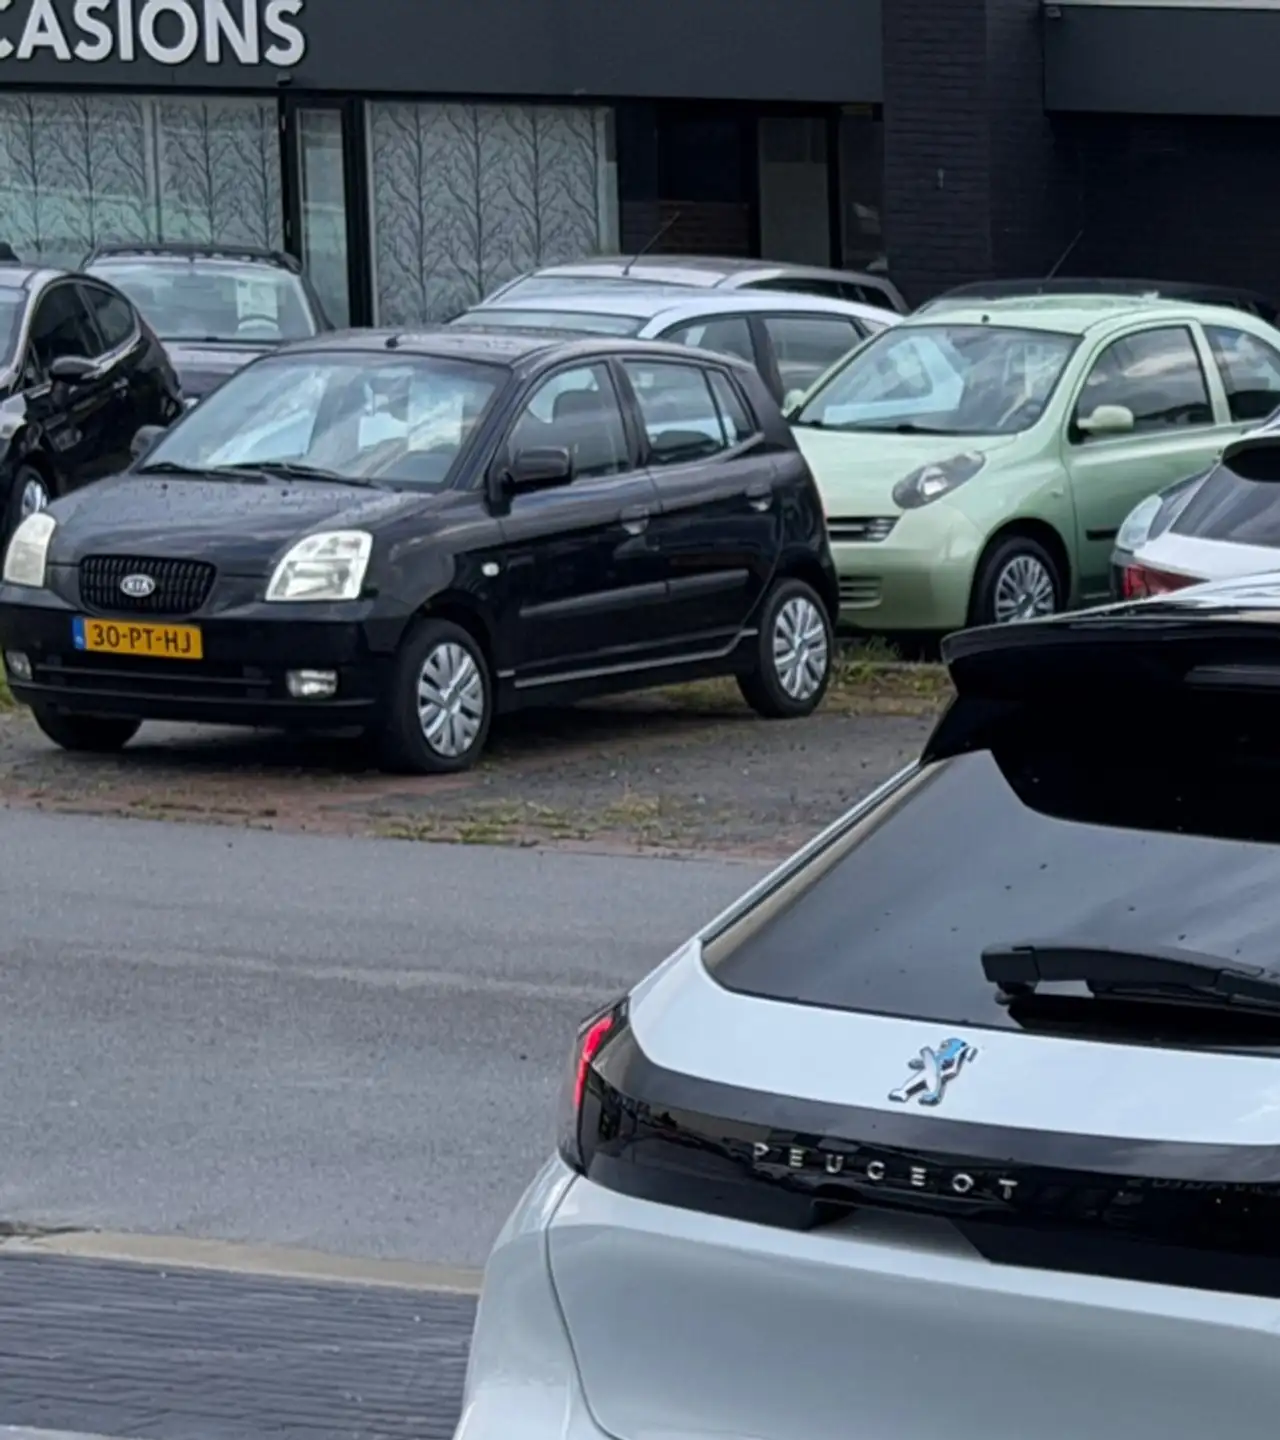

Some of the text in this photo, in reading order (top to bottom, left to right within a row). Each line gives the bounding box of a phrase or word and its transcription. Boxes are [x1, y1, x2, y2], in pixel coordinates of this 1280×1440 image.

[0, 0, 305, 66] ASIONS
[91, 623, 192, 654] 30-PT-HJ
[752, 1141, 1018, 1200] PEUGEOT
